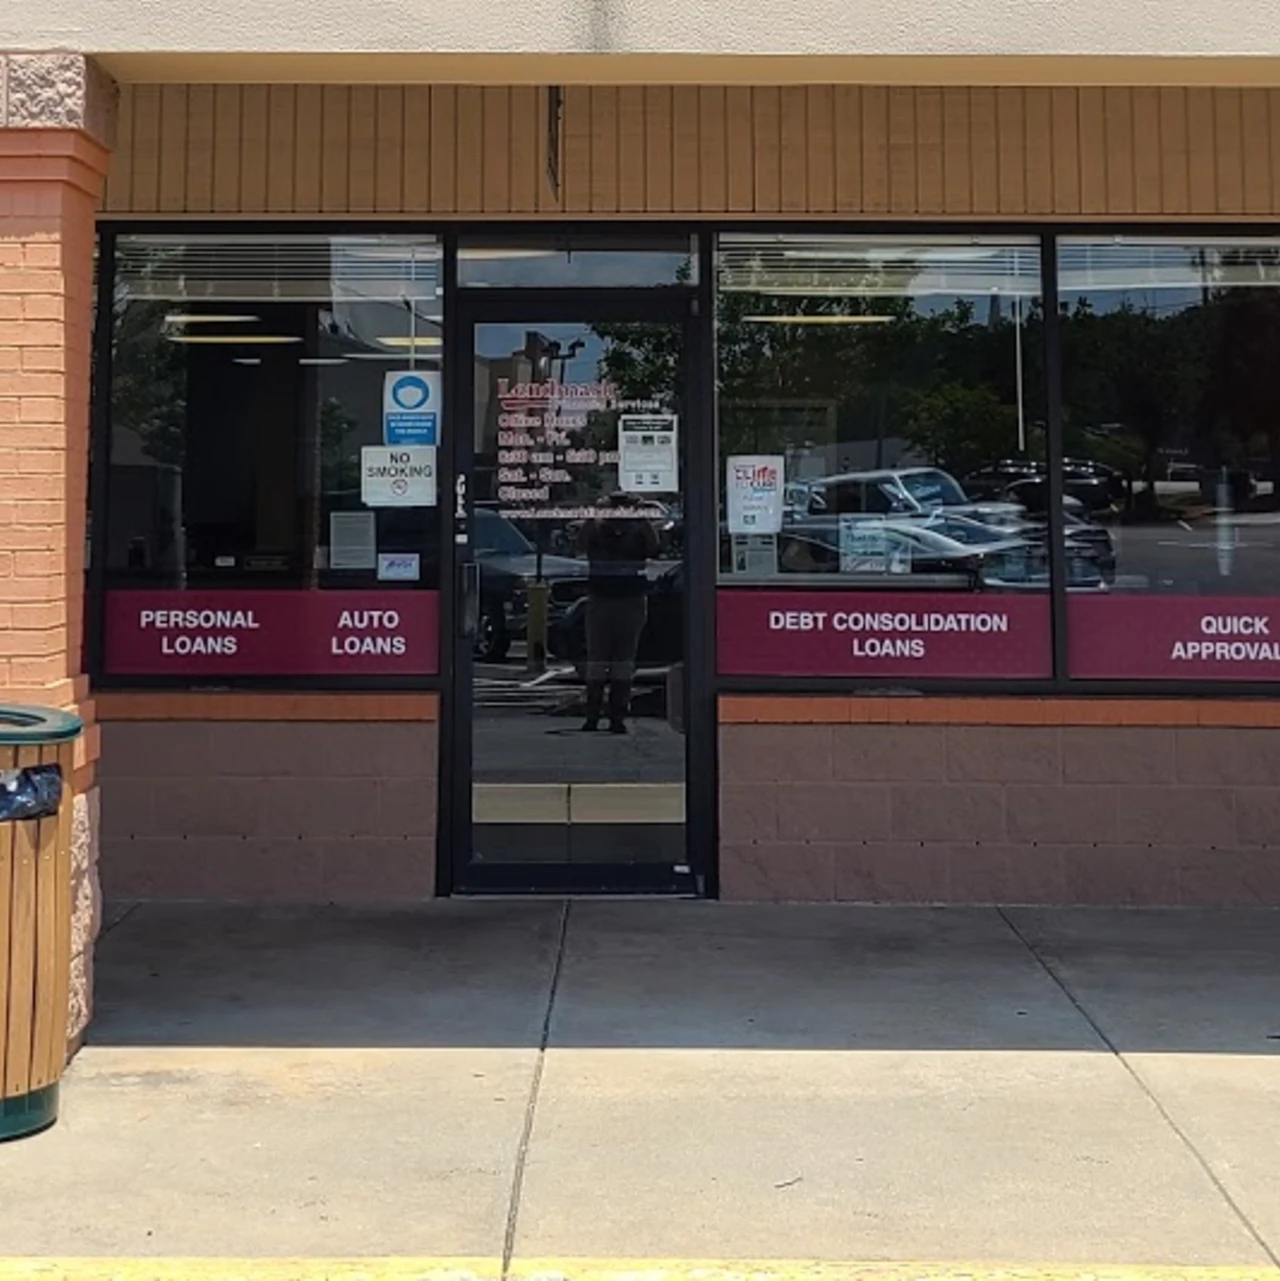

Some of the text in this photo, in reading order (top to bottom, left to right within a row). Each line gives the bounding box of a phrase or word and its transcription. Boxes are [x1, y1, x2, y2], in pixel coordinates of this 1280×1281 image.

[389, 452, 411, 464] NO
[366, 464, 433, 478] SMOKING
[140, 610, 260, 630] PERSONAL
[337, 610, 400, 630] AUTO
[769, 611, 1009, 633] DEBT CONSOLIDATION
[1200, 615, 1269, 635] QUICK
[161, 635, 238, 656] LOANS
[331, 635, 406, 656] LOANS
[852, 637, 925, 658] LOANS
